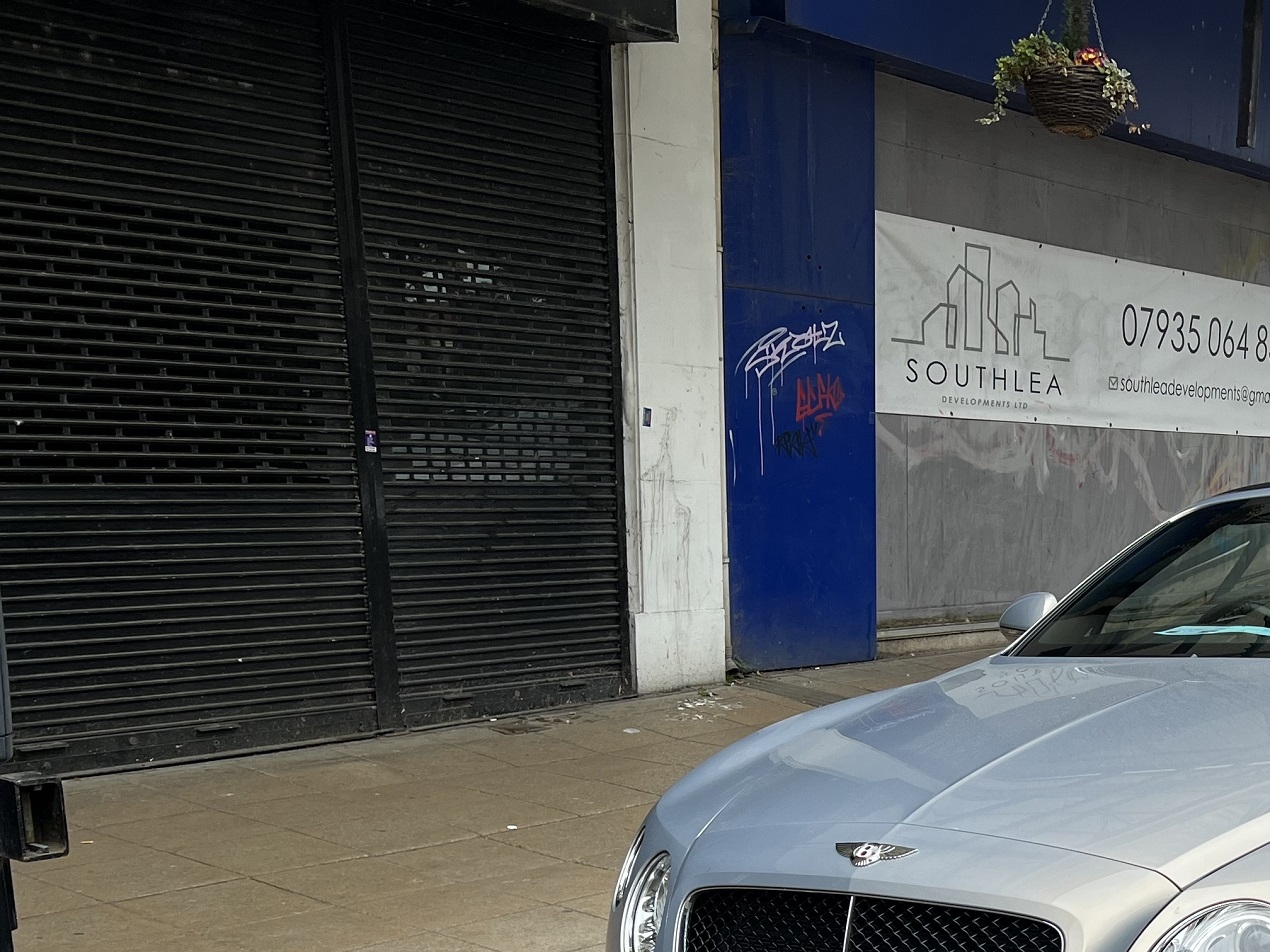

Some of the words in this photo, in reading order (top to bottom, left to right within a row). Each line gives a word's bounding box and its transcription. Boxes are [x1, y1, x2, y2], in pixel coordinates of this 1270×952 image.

[1122, 303, 1201, 354] 07935
[1208, 317, 1249, 360] 064
[905, 358, 1062, 396] SOUTHLEA
[941, 395, 1010, 409] DEVELOPMENTS
[1013, 401, 1029, 410] LTD
